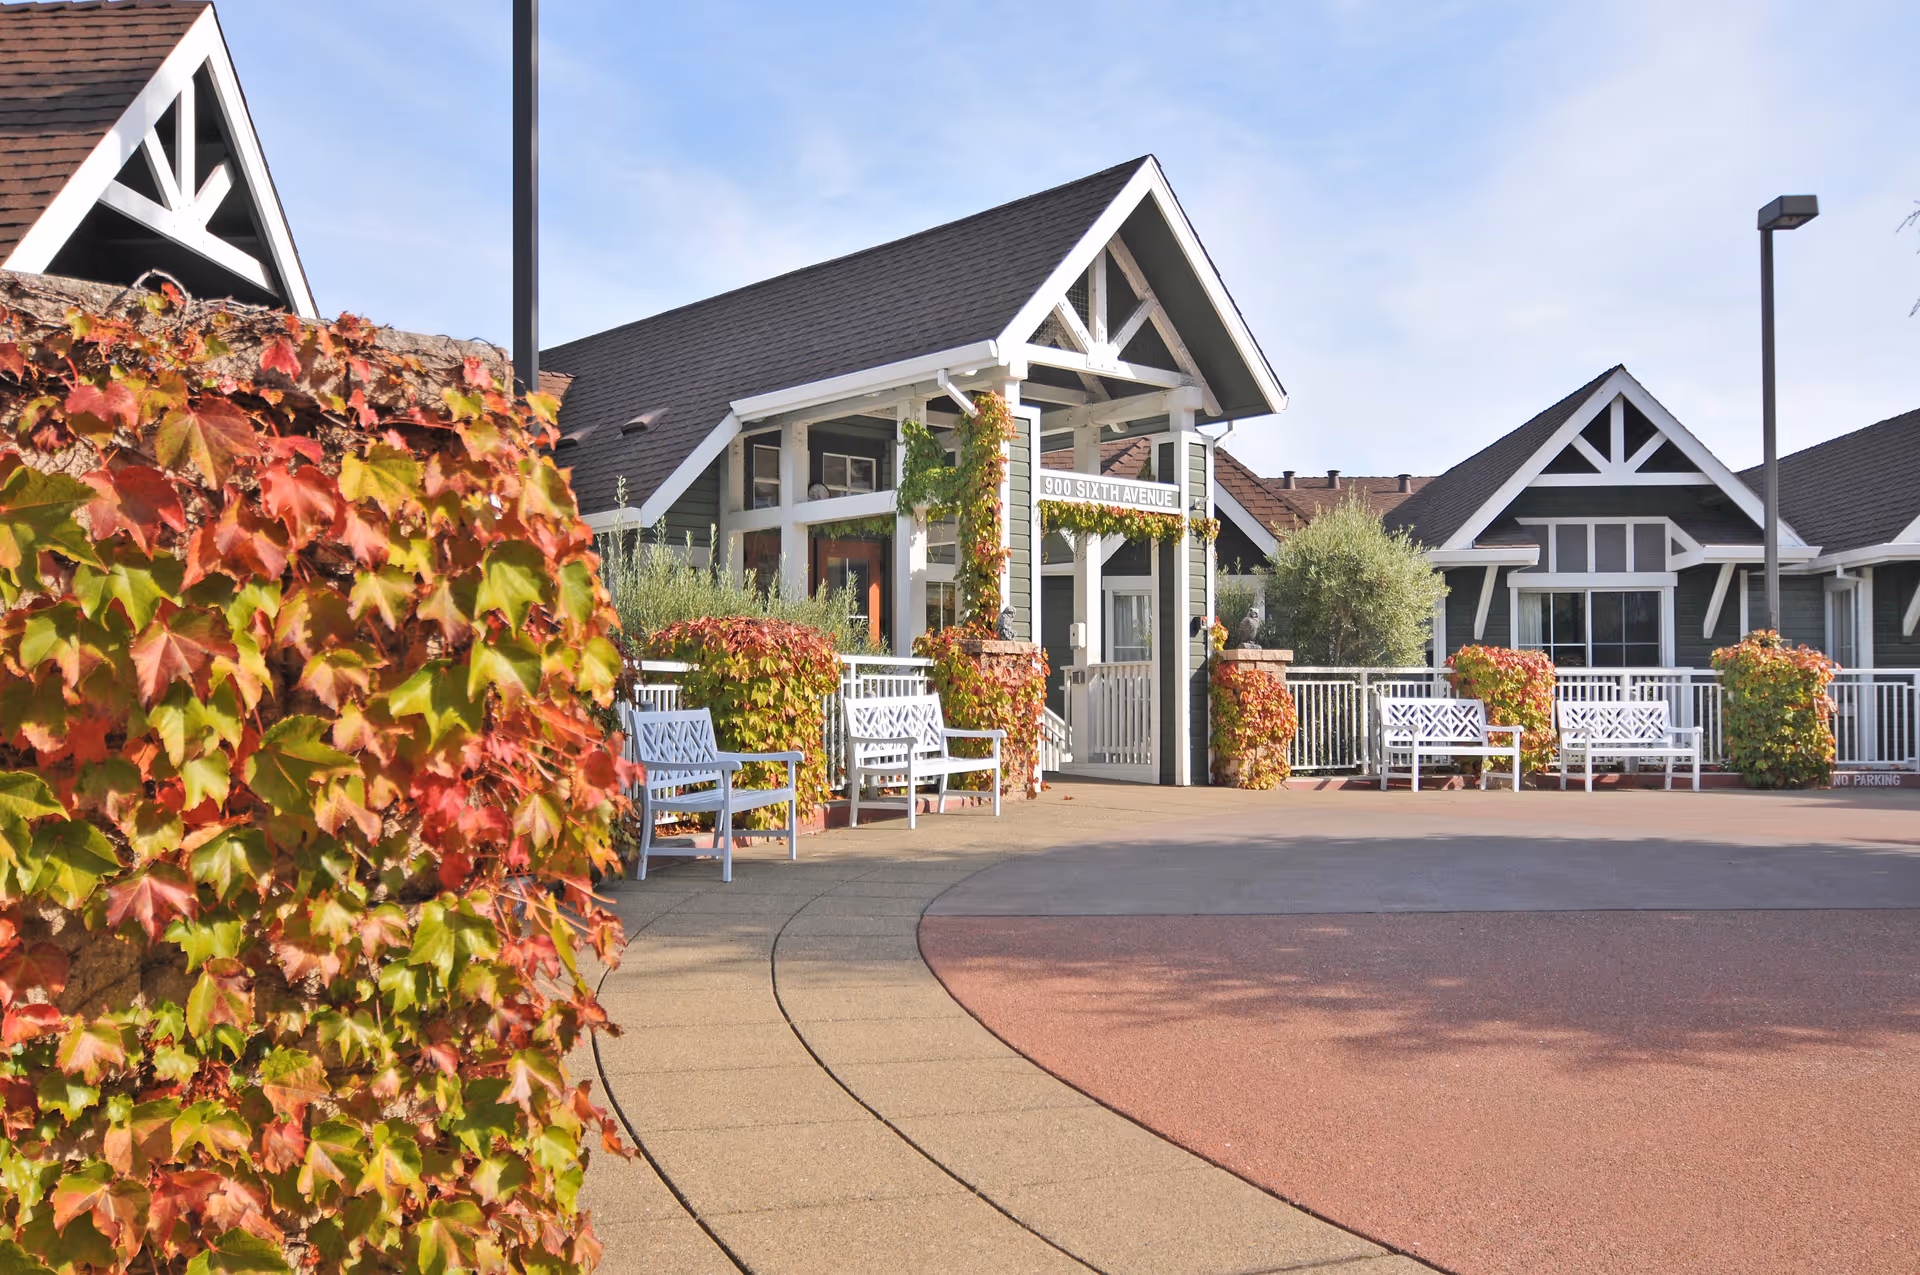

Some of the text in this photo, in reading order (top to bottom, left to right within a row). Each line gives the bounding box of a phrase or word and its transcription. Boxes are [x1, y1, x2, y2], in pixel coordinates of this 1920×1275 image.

[1045, 477, 1173, 506] 900 SIXTH AVENUE
[1833, 774, 1901, 786] NO PARKING
